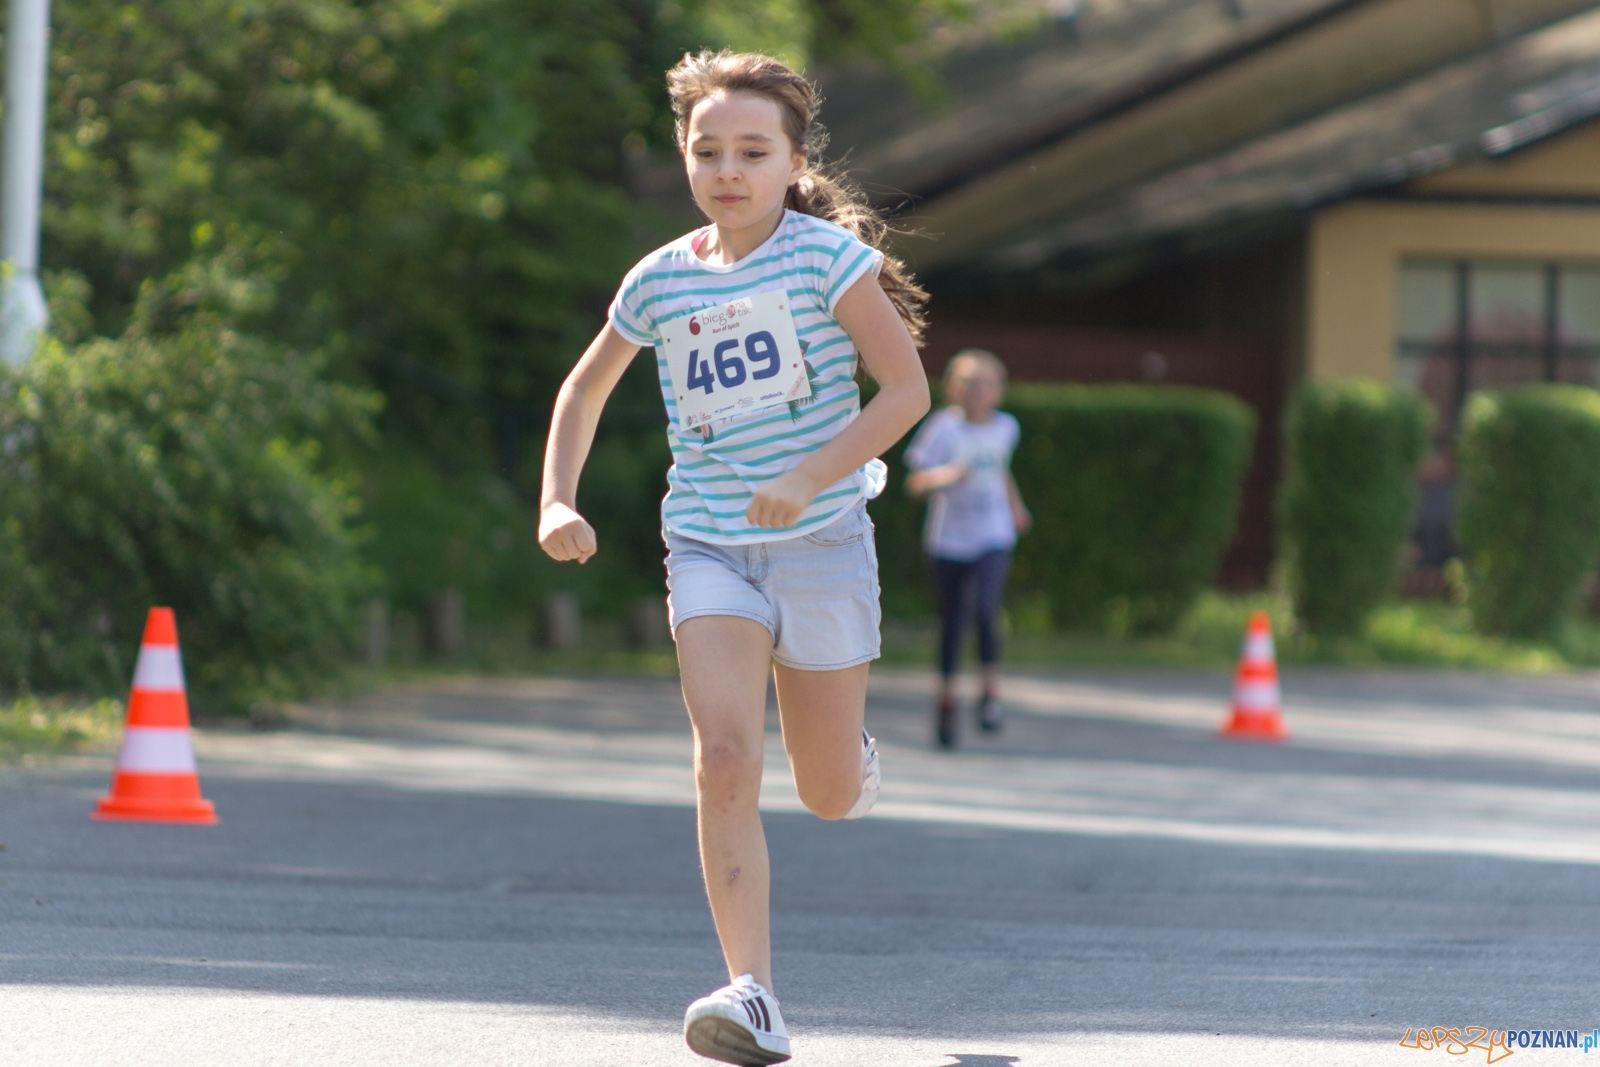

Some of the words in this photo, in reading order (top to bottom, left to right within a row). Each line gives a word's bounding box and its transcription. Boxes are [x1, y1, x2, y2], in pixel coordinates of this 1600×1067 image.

[737, 307, 752, 317] tak
[727, 322, 740, 330] Spirit
[686, 330, 781, 395] 469
